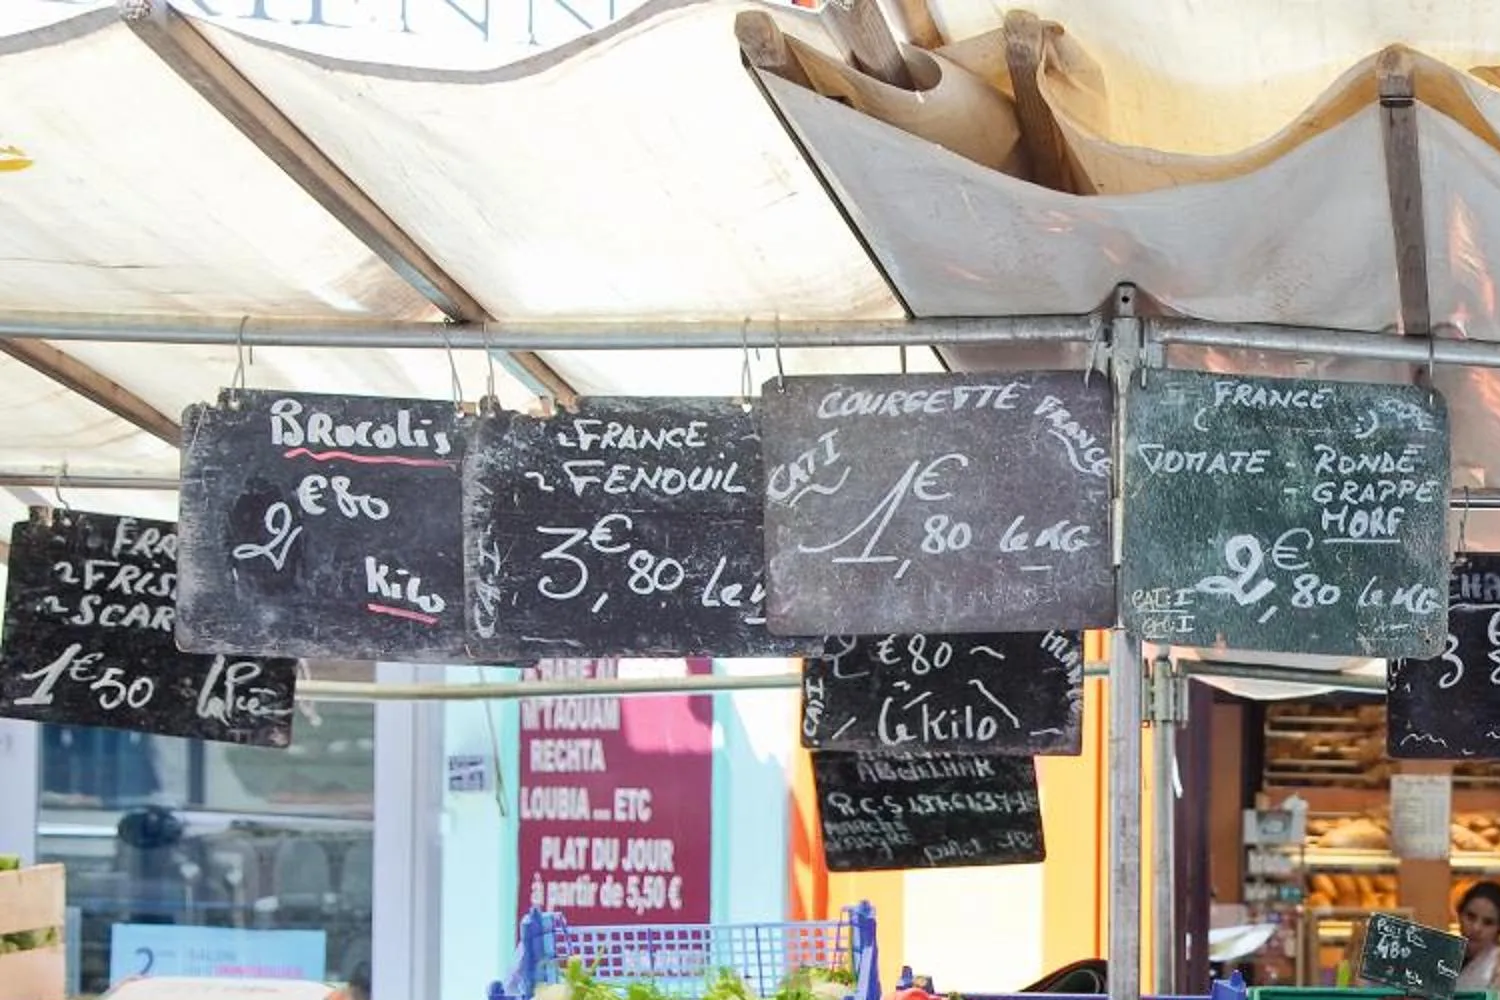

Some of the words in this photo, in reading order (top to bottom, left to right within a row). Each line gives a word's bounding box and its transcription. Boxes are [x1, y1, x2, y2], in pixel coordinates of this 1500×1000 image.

[1213, 381, 1336, 408] FRANCE
[573, 419, 709, 450] FRANCE
[1138, 443, 1272, 475] TOMATE
[1314, 443, 1427, 476] RONDE
[561, 460, 747, 496] FENOUIL
[1312, 480, 1442, 504] GRAPPE
[540, 836, 589, 871] PLAT
[592, 837, 619, 871] DU
[622, 838, 675, 873] JOUR
[547, 875, 598, 912] partir
[601, 875, 625, 908] de
